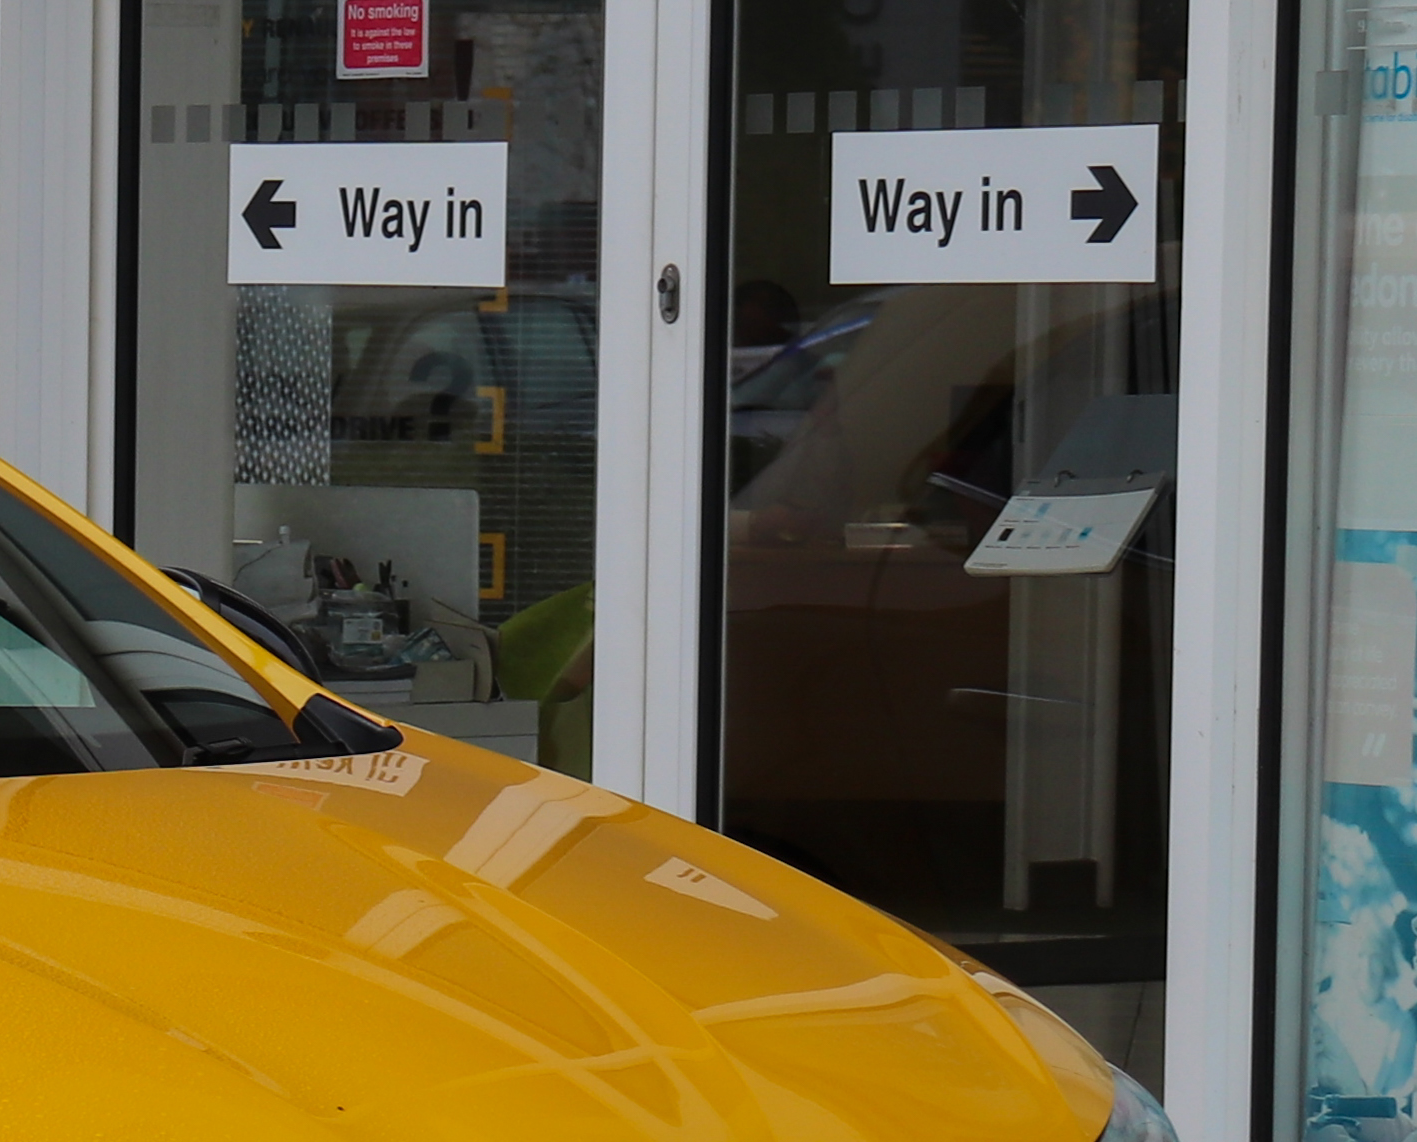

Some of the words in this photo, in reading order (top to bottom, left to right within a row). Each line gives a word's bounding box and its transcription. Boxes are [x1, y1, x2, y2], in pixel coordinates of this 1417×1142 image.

[348, 4, 365, 20] No
[368, 3, 419, 22] smoking
[339, 186, 431, 253] Way
[446, 186, 483, 239] in
[858, 177, 964, 249] Way
[980, 175, 1024, 232] in
